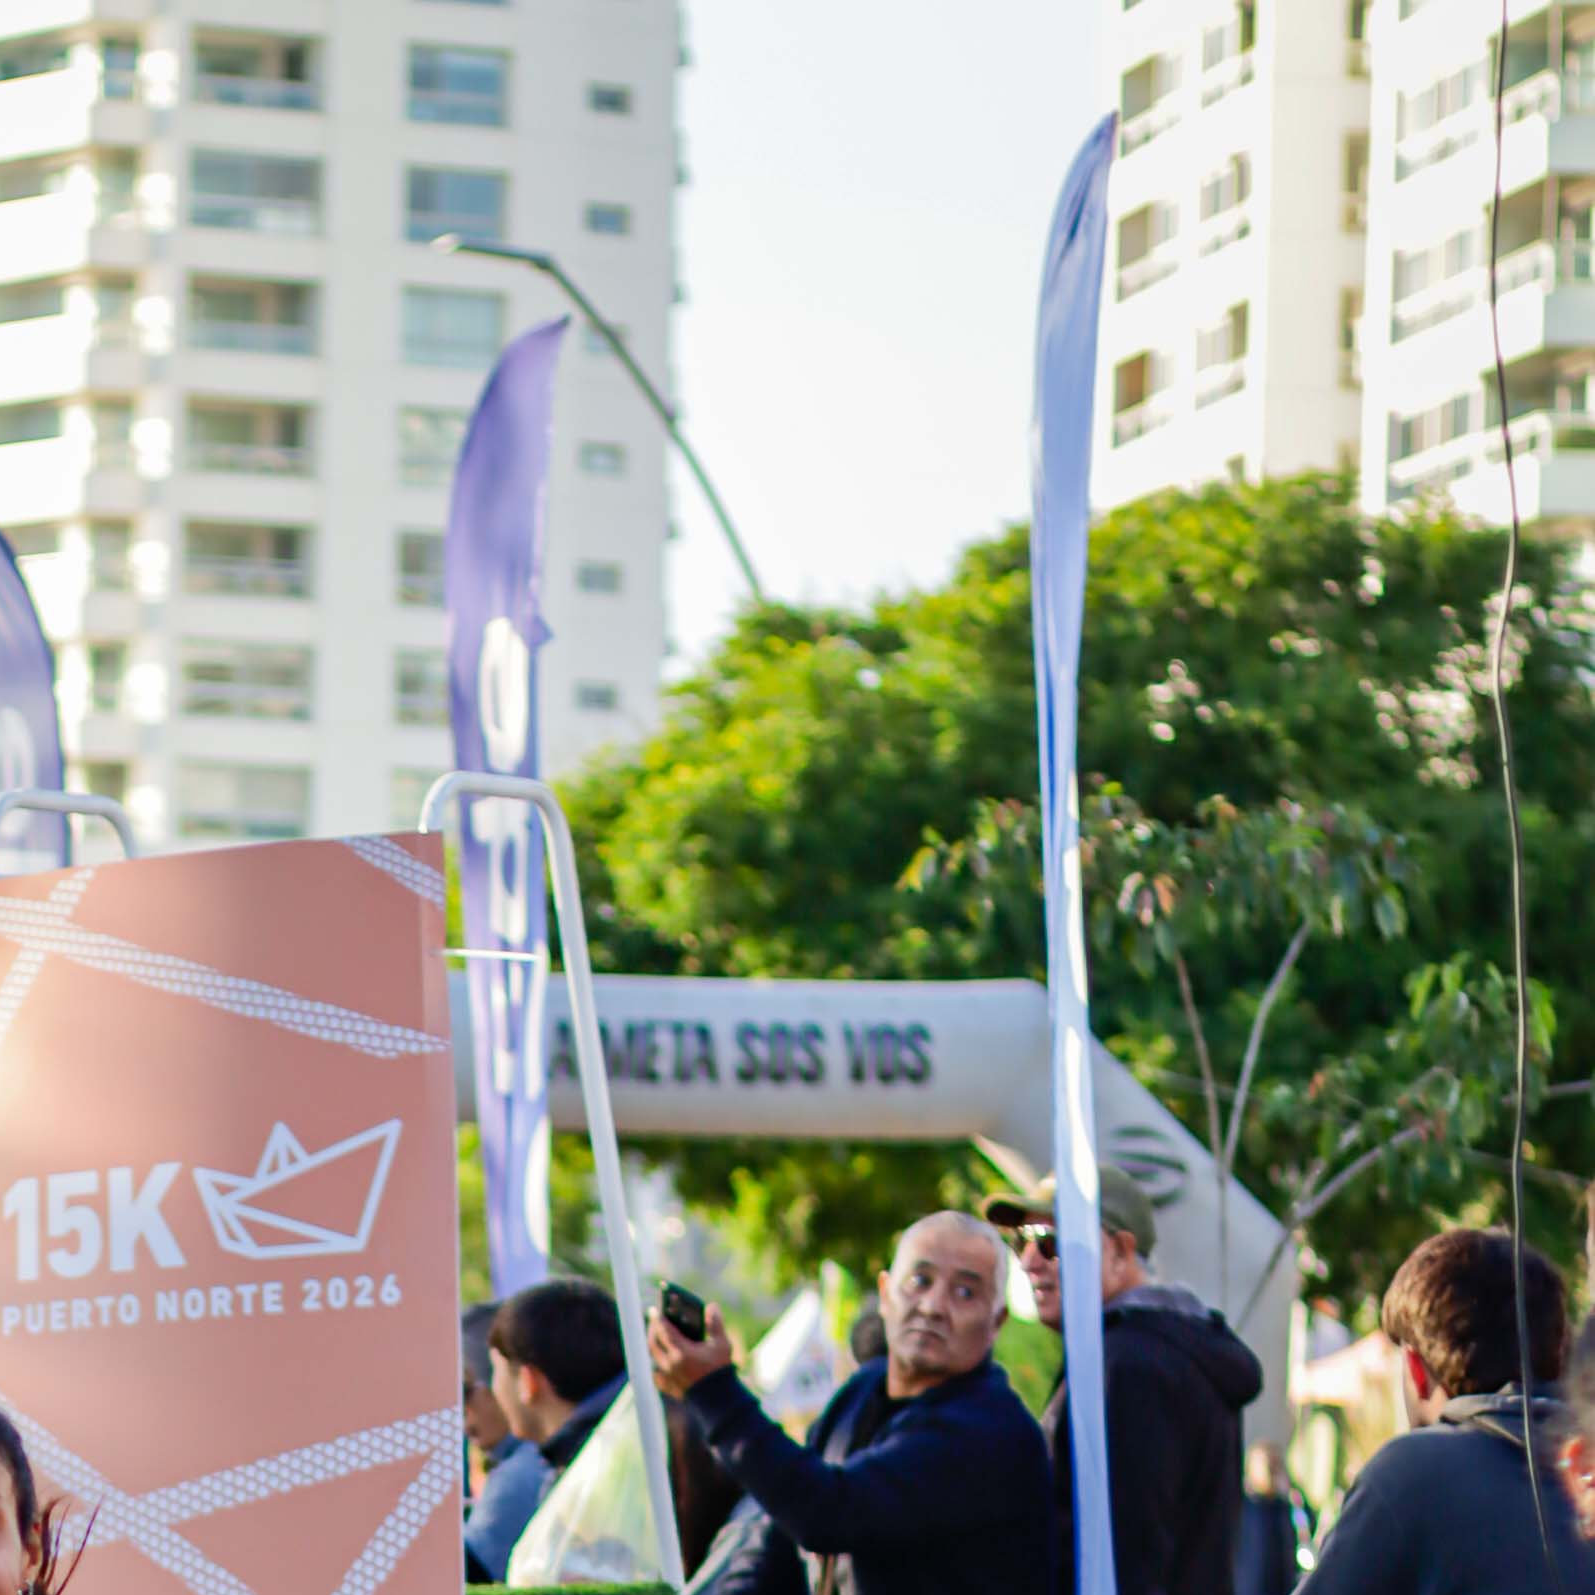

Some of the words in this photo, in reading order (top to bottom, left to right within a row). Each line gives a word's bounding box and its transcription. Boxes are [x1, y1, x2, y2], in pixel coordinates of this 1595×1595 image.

[734, 1020, 826, 1083] SOS
[842, 1021, 932, 1083] VOS
[3, 1162, 187, 1282] 15K
[2, 1294, 141, 1336] PUERTO
[155, 1282, 284, 1322] NORTE
[301, 1274, 403, 1312] 2026
